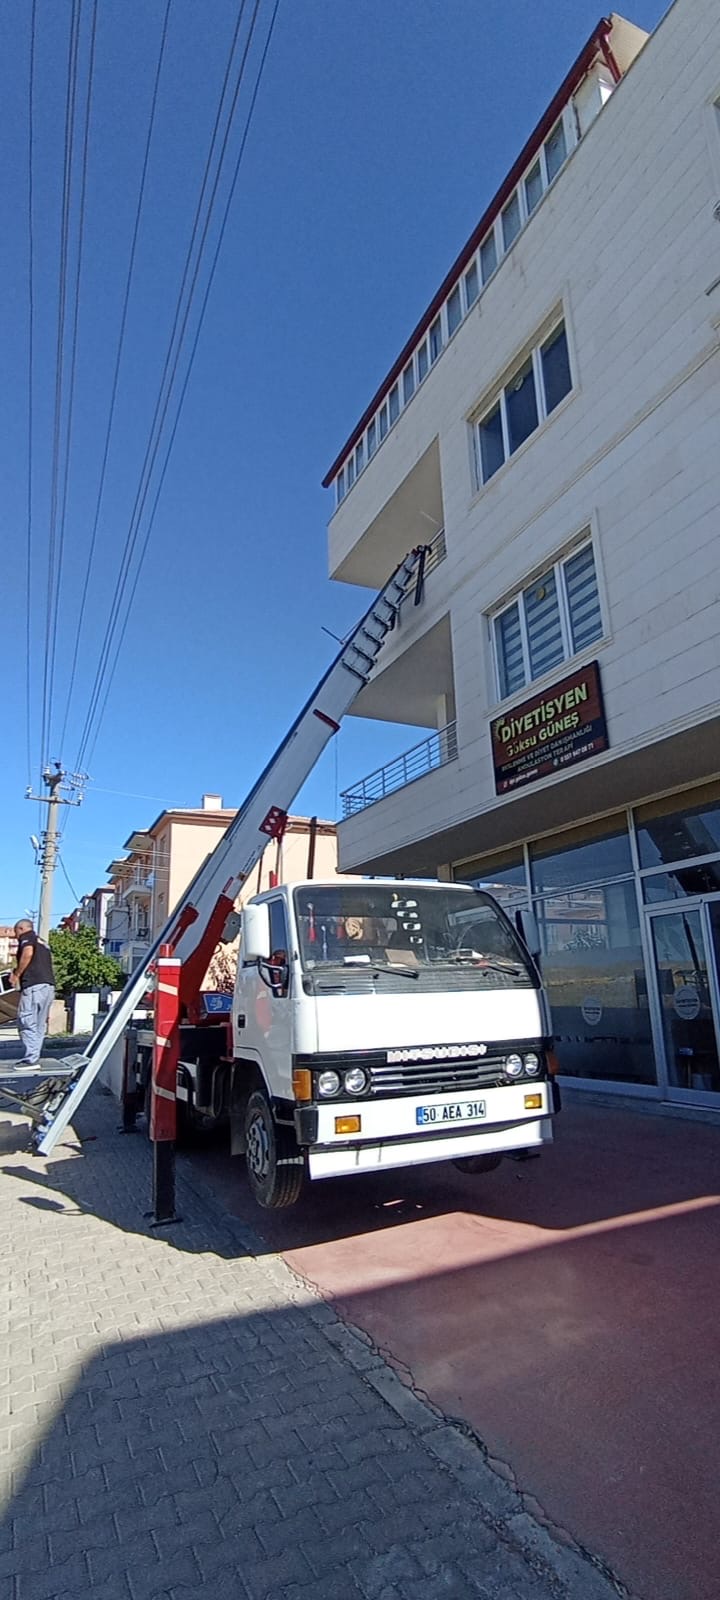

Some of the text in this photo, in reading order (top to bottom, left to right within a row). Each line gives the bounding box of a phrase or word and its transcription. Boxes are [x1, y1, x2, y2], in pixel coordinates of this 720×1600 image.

[501, 683, 588, 743] DİYETİSYEN
[506, 712, 580, 757] Göksu GÜNEŞ
[423, 1107, 436, 1122] 50
[442, 1105, 462, 1120] AEA
[467, 1103, 484, 1117] 314
